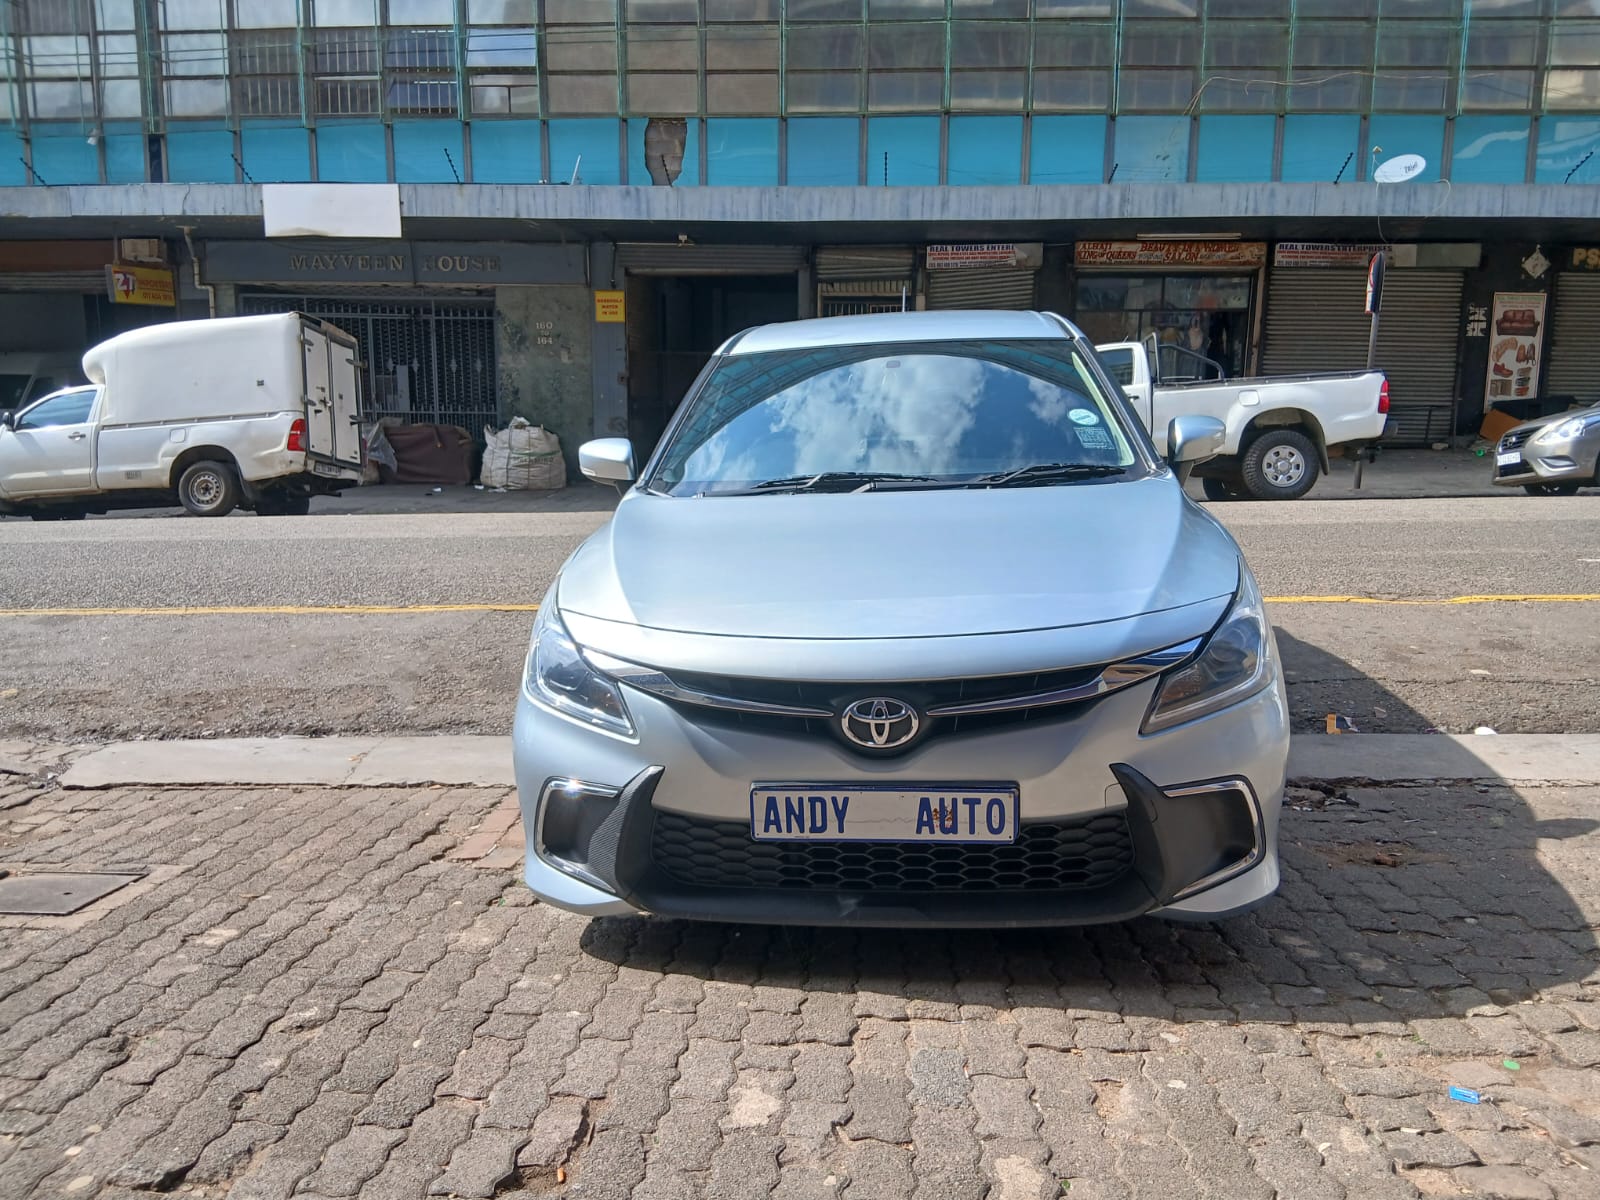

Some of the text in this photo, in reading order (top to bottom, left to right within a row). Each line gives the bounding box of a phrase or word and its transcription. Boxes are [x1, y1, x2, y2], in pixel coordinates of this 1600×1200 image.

[951, 244, 985, 252] TOWERS
[290, 255, 499, 272] MAYVEEN HOUSE
[536, 321, 553, 330] 160
[537, 337, 553, 345] 164
[763, 796, 1006, 835] ANDY AUTO
